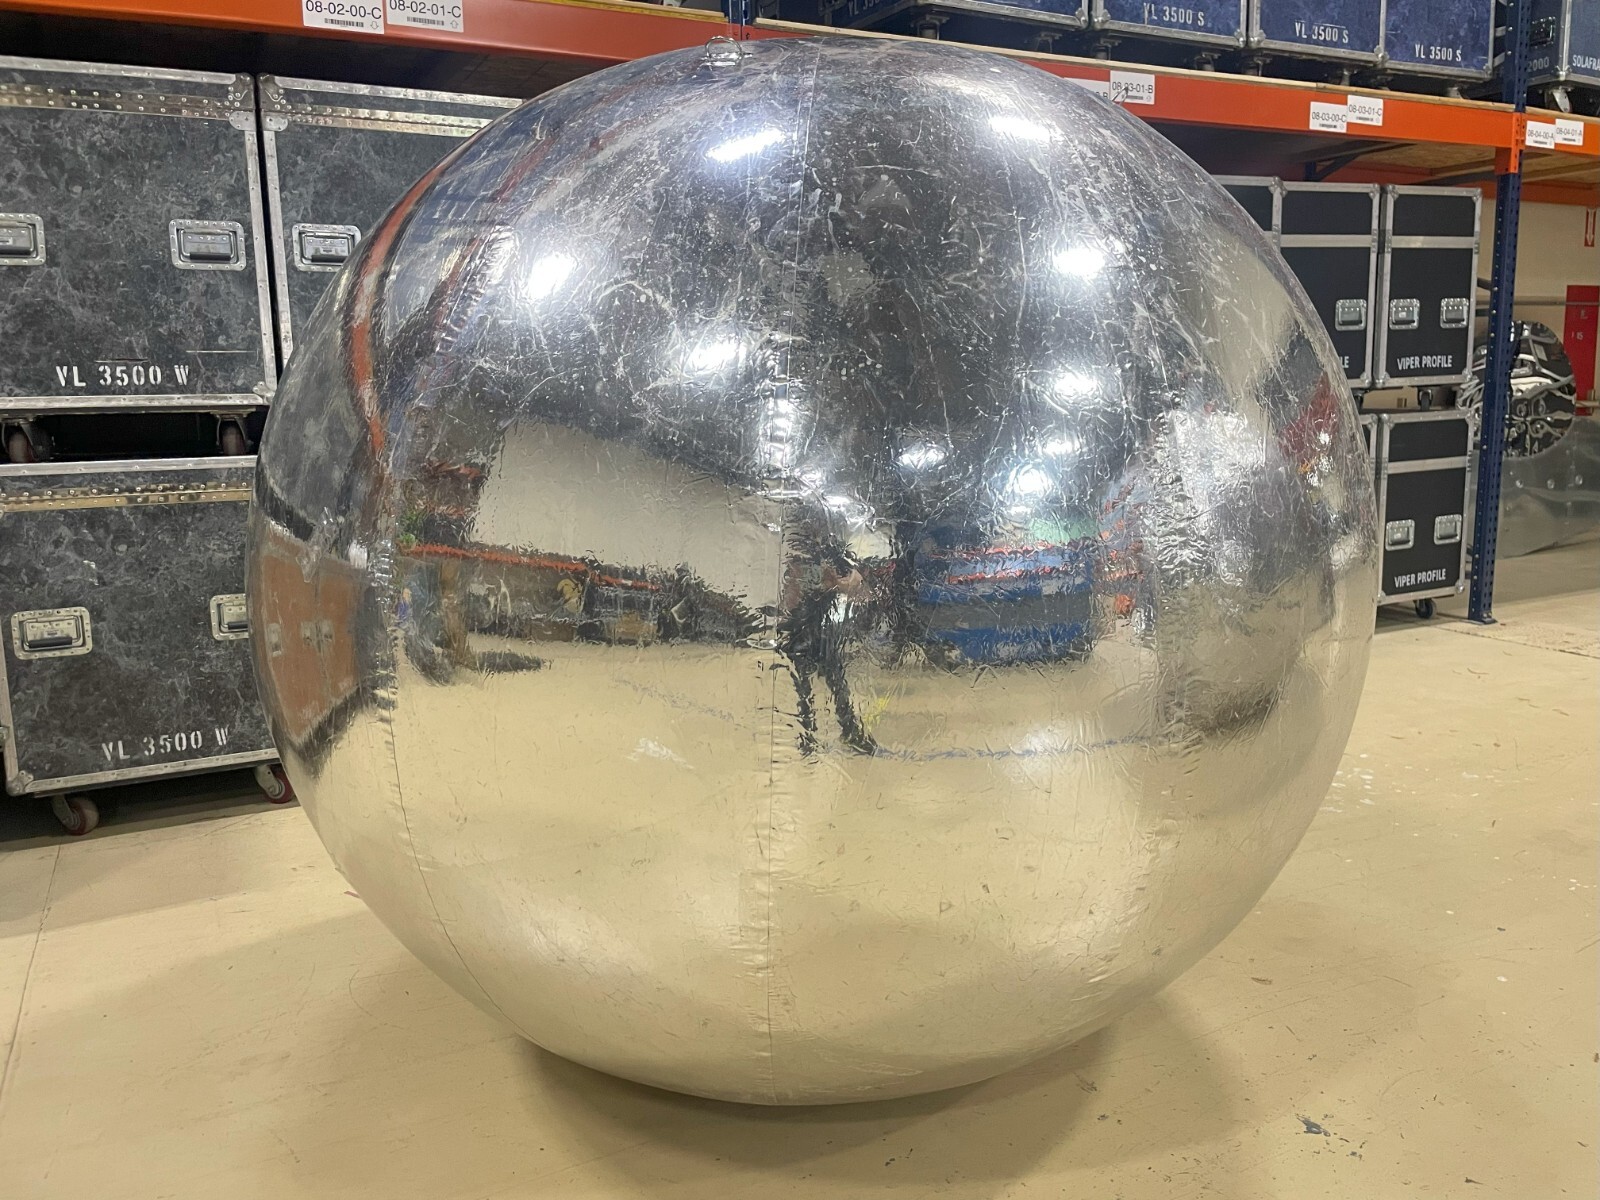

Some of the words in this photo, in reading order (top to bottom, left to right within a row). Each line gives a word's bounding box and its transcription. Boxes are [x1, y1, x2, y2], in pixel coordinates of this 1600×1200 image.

[305, 0, 382, 20] 08-02-00-C
[389, 0, 462, 19] 08-02-01-C
[1143, 2, 1158, 20] VL
[1162, 5, 1193, 25] 3500
[1197, 11, 1205, 27] S
[1294, 21, 1308, 39] VL
[1312, 25, 1339, 42] 3500
[1342, 29, 1349, 44] S
[1414, 43, 1426, 59] VL
[1429, 46, 1453, 61] 3500
[1455, 49, 1462, 62] S
[1311, 111, 1347, 123] 08-03-00-C
[1348, 104, 1382, 117] 08-03-01-C
[1397, 356, 1420, 371] VIPER
[1421, 355, 1453, 368] PROFILE
[55, 365, 87, 387] VL
[98, 365, 162, 387] 3500
[173, 364, 189, 386] W
[1394, 573, 1416, 588] VIPER
[1417, 568, 1446, 584] PROFILE
[101, 740, 131, 761] VL
[142, 730, 203, 756] 3500
[214, 725, 229, 746] W
